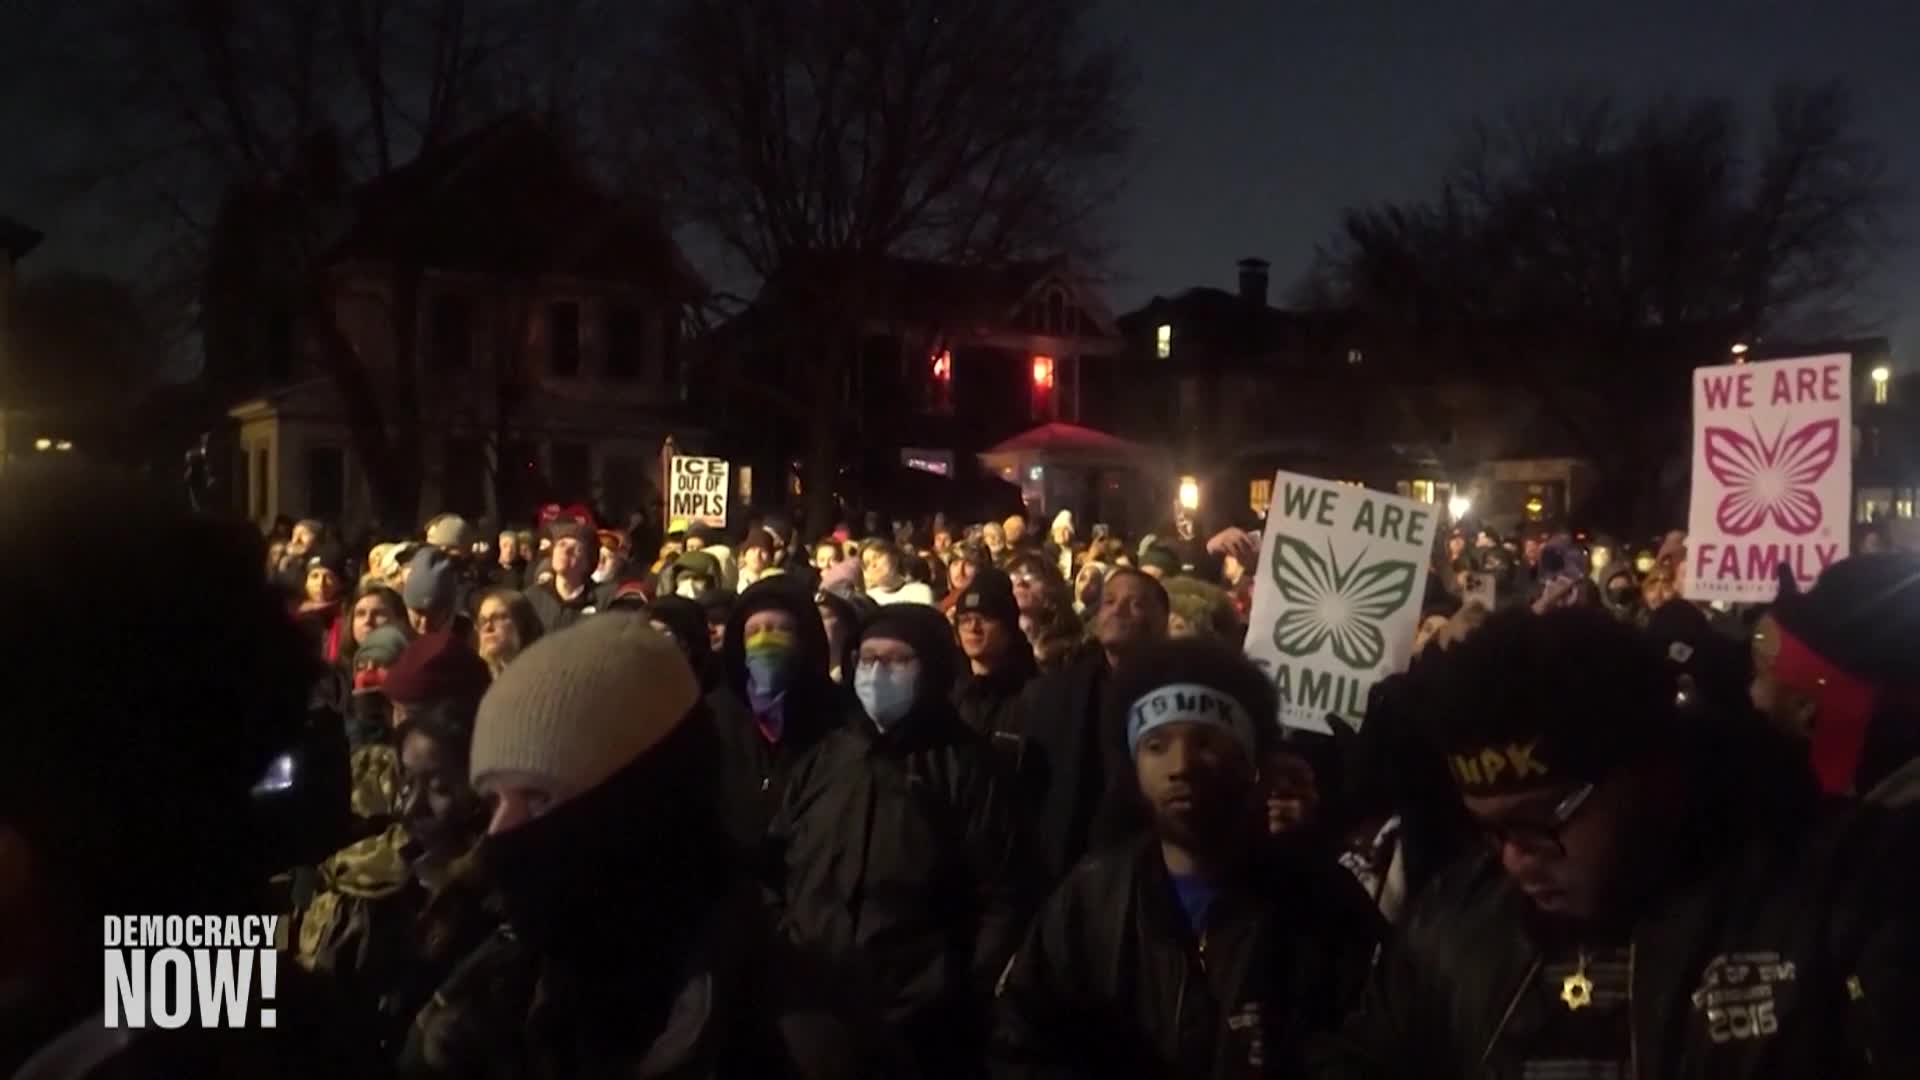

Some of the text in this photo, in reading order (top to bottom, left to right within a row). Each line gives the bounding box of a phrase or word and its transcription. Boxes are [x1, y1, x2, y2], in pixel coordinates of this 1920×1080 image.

[1703, 365, 1841, 410] WE ARE
[676, 459, 725, 476] ICE
[678, 475, 721, 492] OUT OF
[674, 494, 723, 516] MPLS
[1285, 482, 1429, 547] WE ARE
[1260, 658, 1364, 719] AMIL
